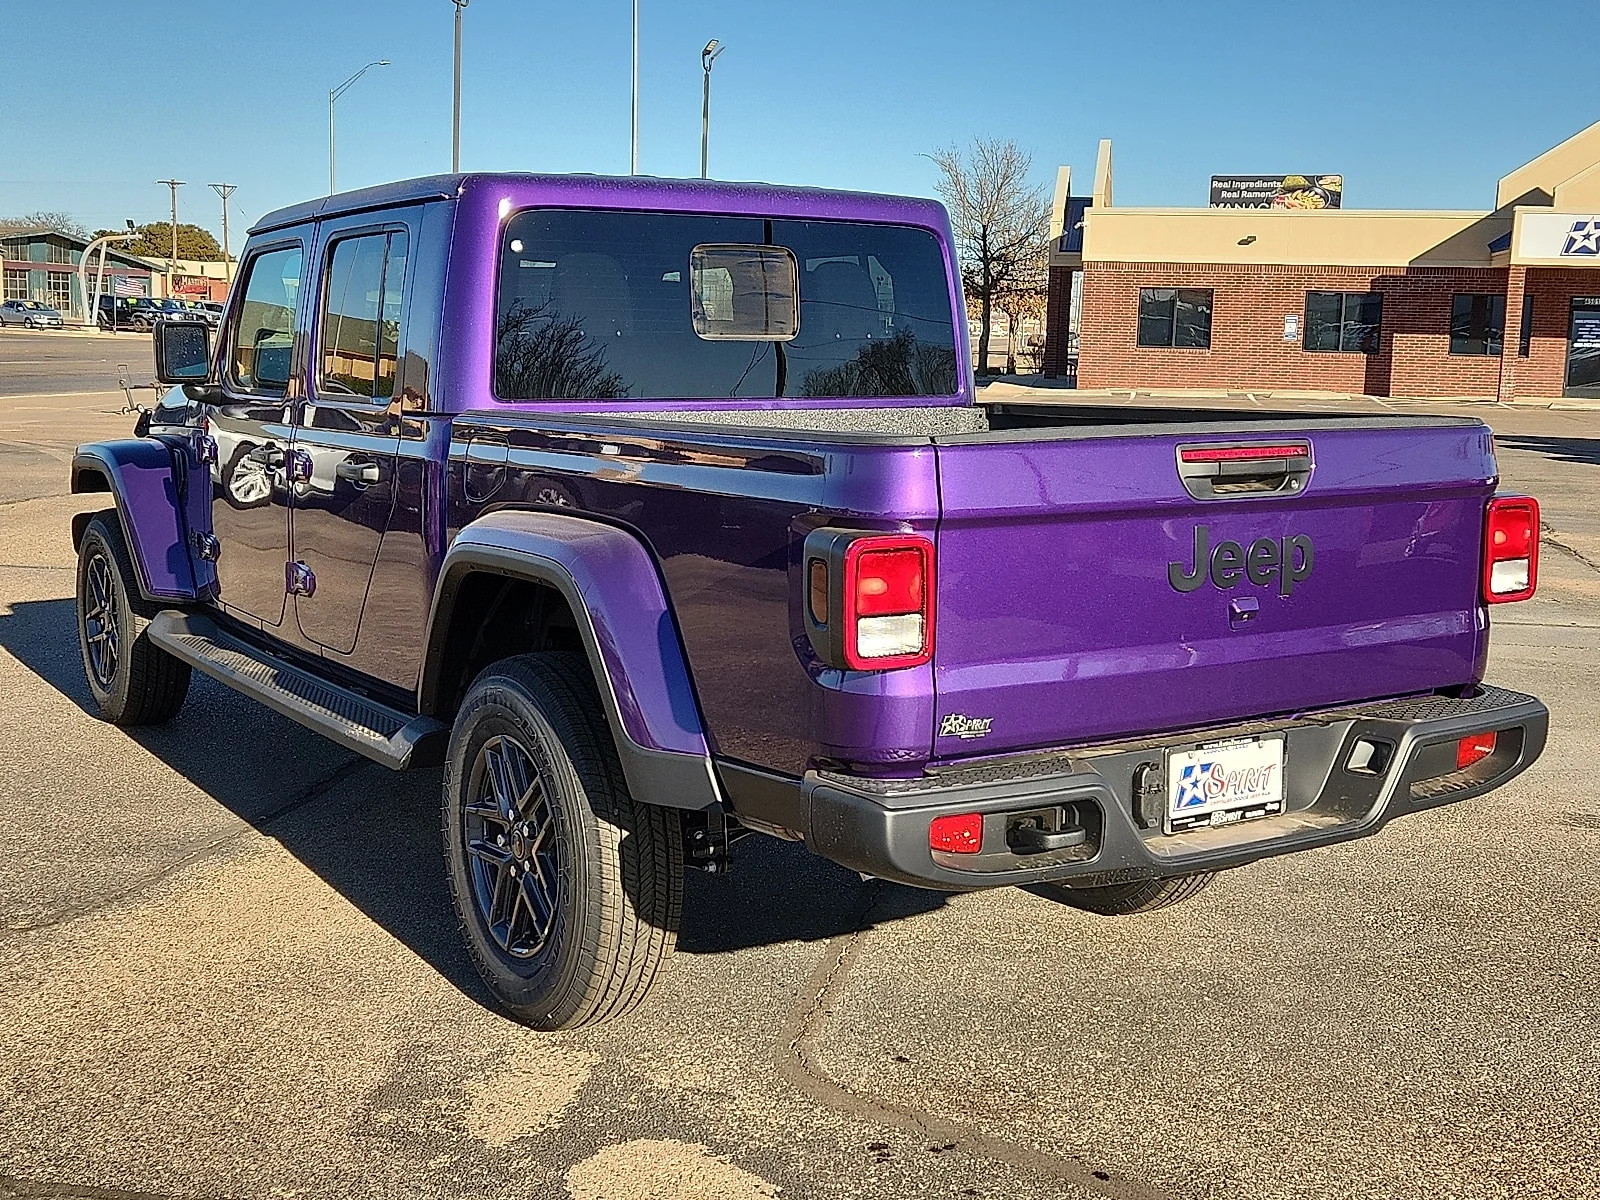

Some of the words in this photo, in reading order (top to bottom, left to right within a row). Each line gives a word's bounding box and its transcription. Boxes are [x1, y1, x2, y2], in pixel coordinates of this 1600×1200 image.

[1212, 180, 1231, 188] Real
[1221, 190, 1240, 198] Real
[1168, 524, 1314, 595] Jeep
[958, 715, 994, 731] SPIRIT
[1208, 763, 1277, 797] SPIRIT
